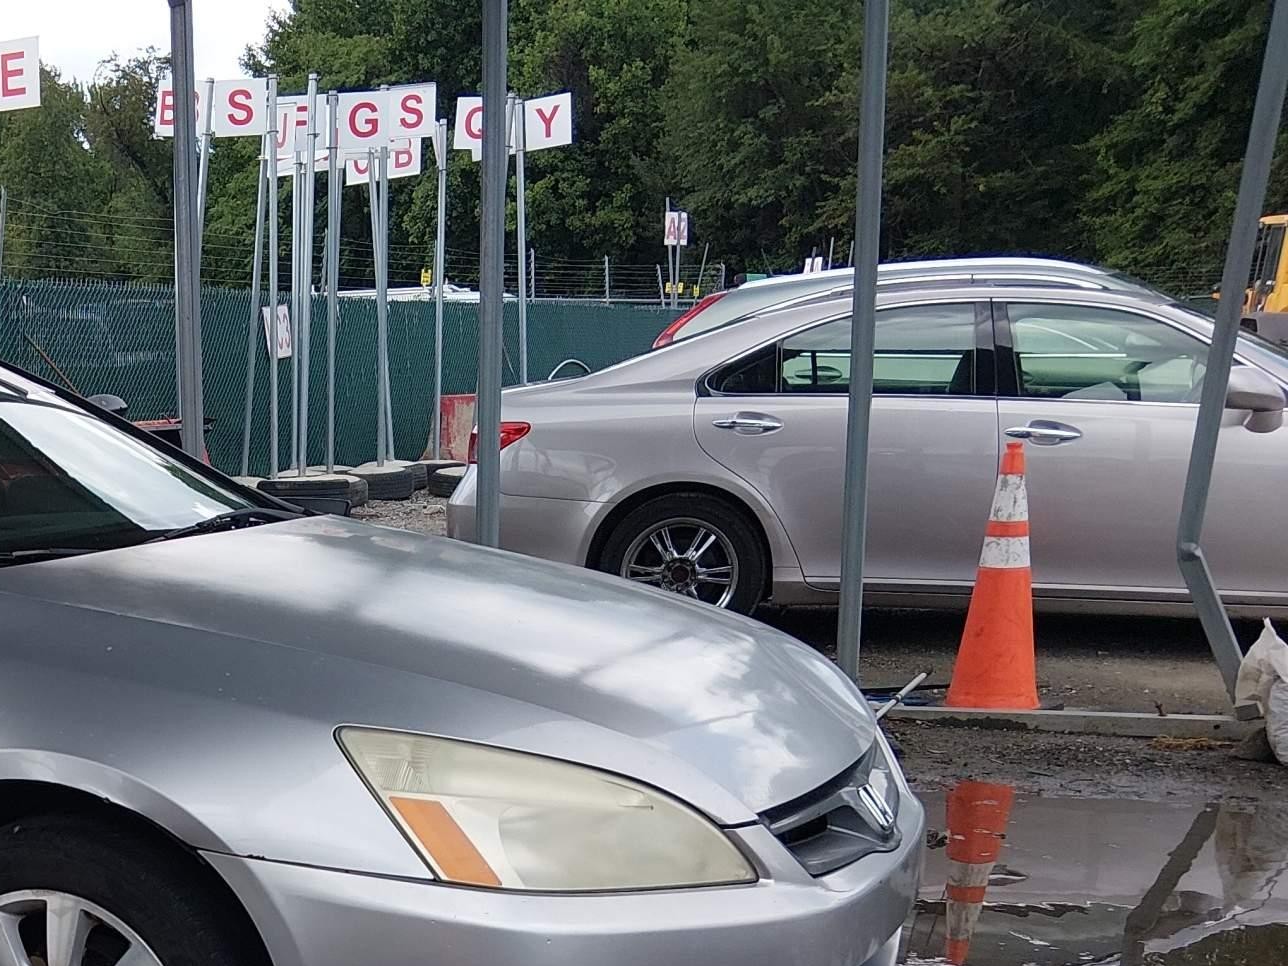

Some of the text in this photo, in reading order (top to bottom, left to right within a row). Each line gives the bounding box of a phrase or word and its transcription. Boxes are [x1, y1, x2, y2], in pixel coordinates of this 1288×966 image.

[1, 51, 26, 97] E
[227, 89, 254, 125] S
[348, 102, 379, 138] G
[399, 94, 424, 129] S
[535, 104, 560, 138] Y
